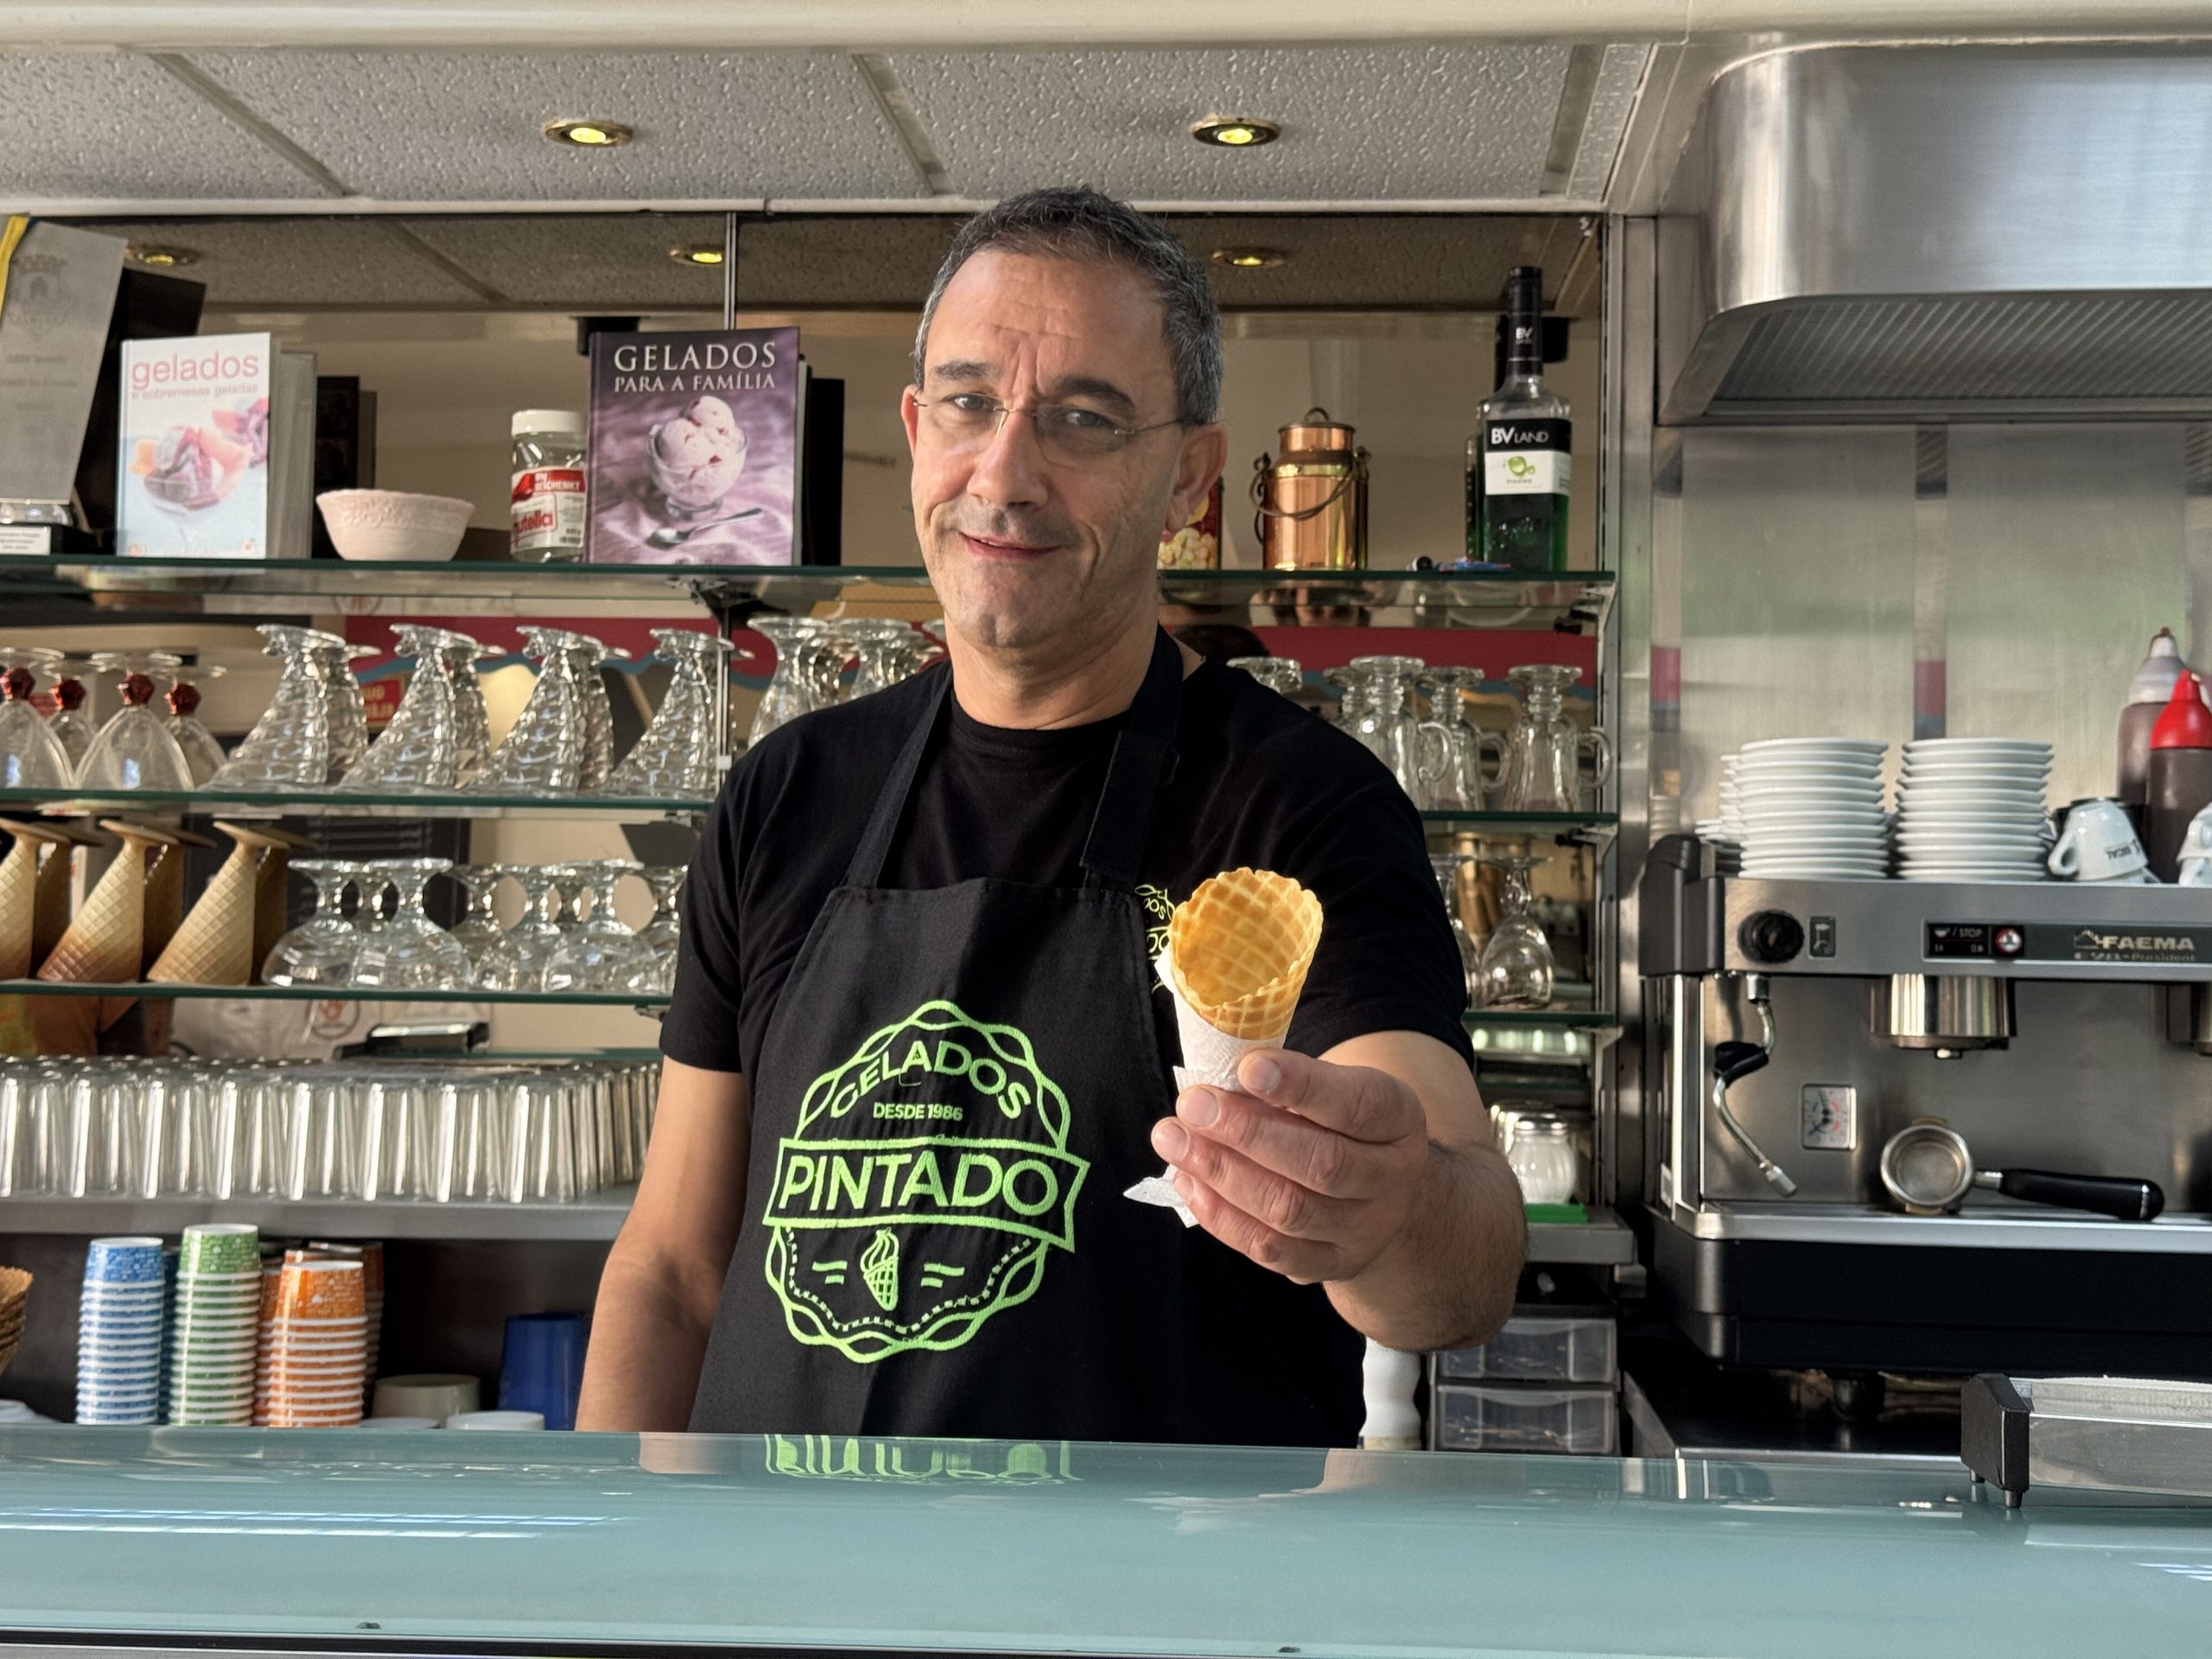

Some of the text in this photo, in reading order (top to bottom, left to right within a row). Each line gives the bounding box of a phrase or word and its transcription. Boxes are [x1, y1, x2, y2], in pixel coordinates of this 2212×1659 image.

[613, 341, 776, 372] GELADOS
[130, 349, 259, 391] gelados
[614, 371, 775, 393] PARA A FAMÍLIA
[1959, 928, 1983, 938] STOP
[2101, 935, 2196, 950] FAEMA
[830, 1039, 1032, 1119] GELADOS
[873, 1102, 963, 1122] DESDE 1986
[779, 1150, 1059, 1217] PINTADO
